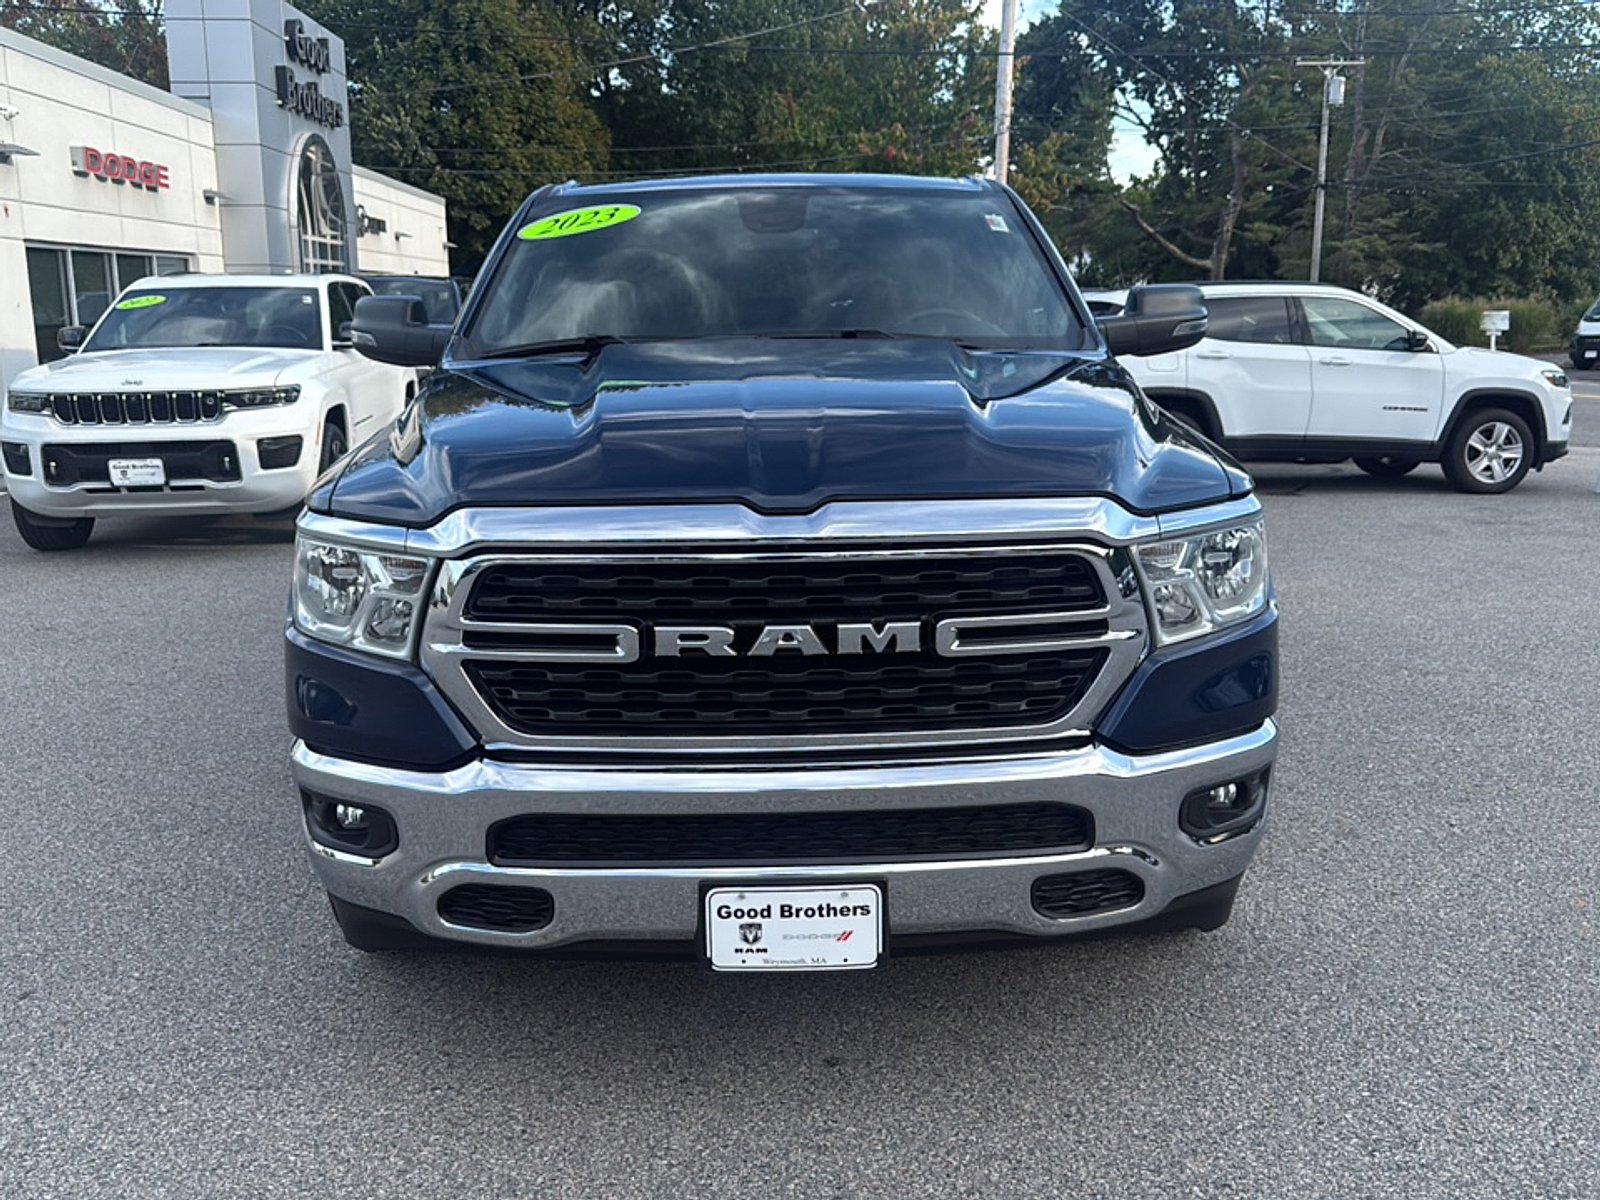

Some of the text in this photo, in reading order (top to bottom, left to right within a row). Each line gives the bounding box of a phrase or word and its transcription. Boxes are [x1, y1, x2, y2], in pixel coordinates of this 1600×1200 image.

[286, 19, 331, 74] Good
[277, 65, 343, 129] Brothers
[78, 147, 170, 190] DODGE
[536, 207, 620, 235] 2023
[654, 621, 922, 656] RAM
[716, 902, 871, 920] Good Brothers
